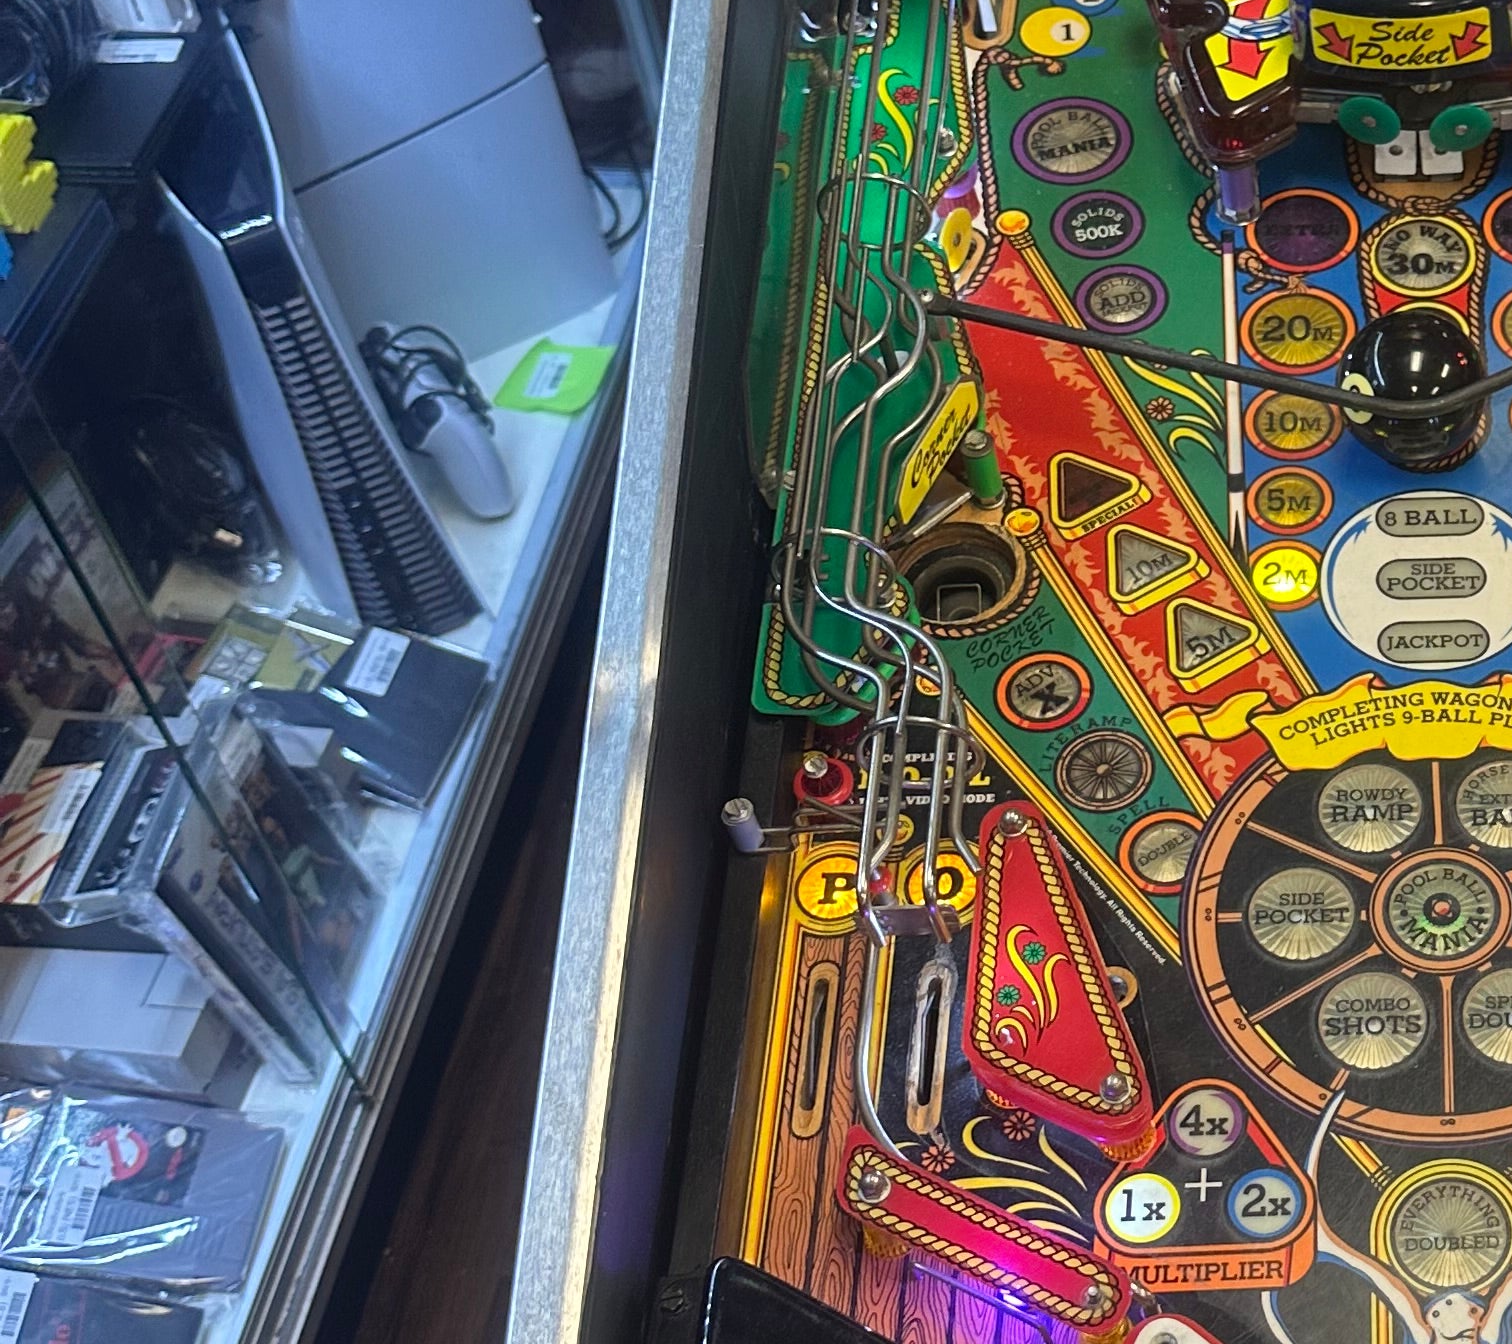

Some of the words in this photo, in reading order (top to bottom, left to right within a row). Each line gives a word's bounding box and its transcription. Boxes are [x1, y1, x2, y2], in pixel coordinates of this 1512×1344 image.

[1061, 24, 1074, 40] 1
[1369, 21, 1434, 42] Side
[1355, 44, 1449, 65] Pocket
[1071, 208, 1125, 227] SOLIDS
[1075, 224, 1123, 241] 500K
[1386, 232, 1414, 256] NO
[1420, 226, 1461, 254] WAY
[1387, 253, 1454, 276] 30M
[1385, 510, 1398, 526] 8
[1406, 508, 1478, 526] BALL
[1411, 564, 1455, 575] SIDE
[1386, 576, 1480, 592] POCKET
[966, 606, 1049, 658] CORNER
[1387, 633, 1484, 650] JACKPOT
[972, 619, 1055, 673] POCKET
[1015, 666, 1055, 697] ADV
[1279, 691, 1424, 741] COMPLETING
[1312, 712, 1396, 747] LIGHTS
[1402, 710, 1481, 728] 9-BALL
[1463, 765, 1509, 800] HORSE
[1336, 789, 1407, 803] ROWDY
[1108, 796, 1170, 835] SPELL
[1331, 802, 1414, 822] RAMP
[1139, 831, 1192, 867] DOUBLE
[1394, 869, 1438, 904] POOL
[1443, 868, 1484, 901] BALL
[1279, 892, 1324, 905] SIDE
[1254, 907, 1349, 925] POCKET
[1401, 915, 1485, 951] MANIA
[1335, 998, 1410, 1013] COMBO
[1324, 1015, 1422, 1036] SHOTS
[1179, 1105, 1228, 1137] 4x
[1119, 1188, 1166, 1222] 1x
[1242, 1183, 1290, 1217] 2x
[1400, 1184, 1501, 1231] EVERYTHING
[1404, 1233, 1500, 1253] DOUBLED
